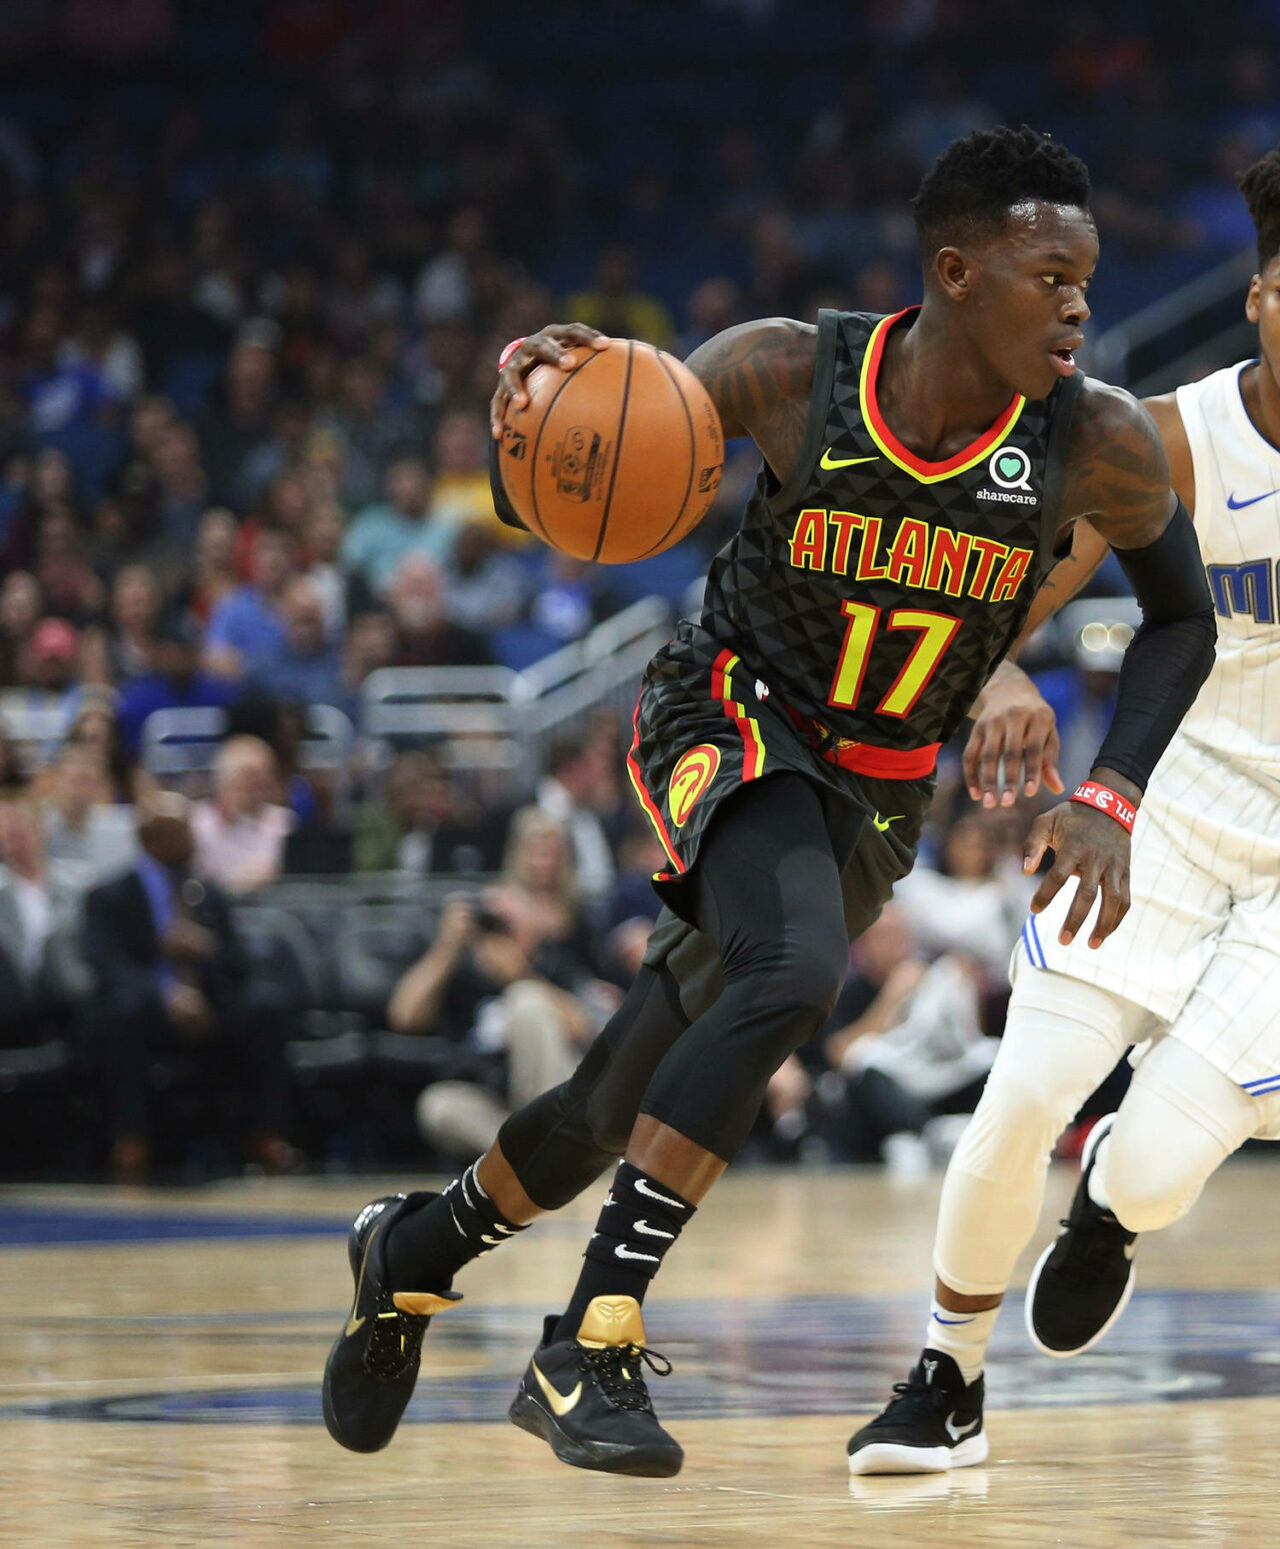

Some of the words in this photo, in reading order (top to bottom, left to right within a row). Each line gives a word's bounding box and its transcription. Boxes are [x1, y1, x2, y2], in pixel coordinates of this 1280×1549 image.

[976, 488, 1037, 505] sharecare
[789, 508, 1034, 603] ATLANTA
[827, 600, 963, 719] 17
